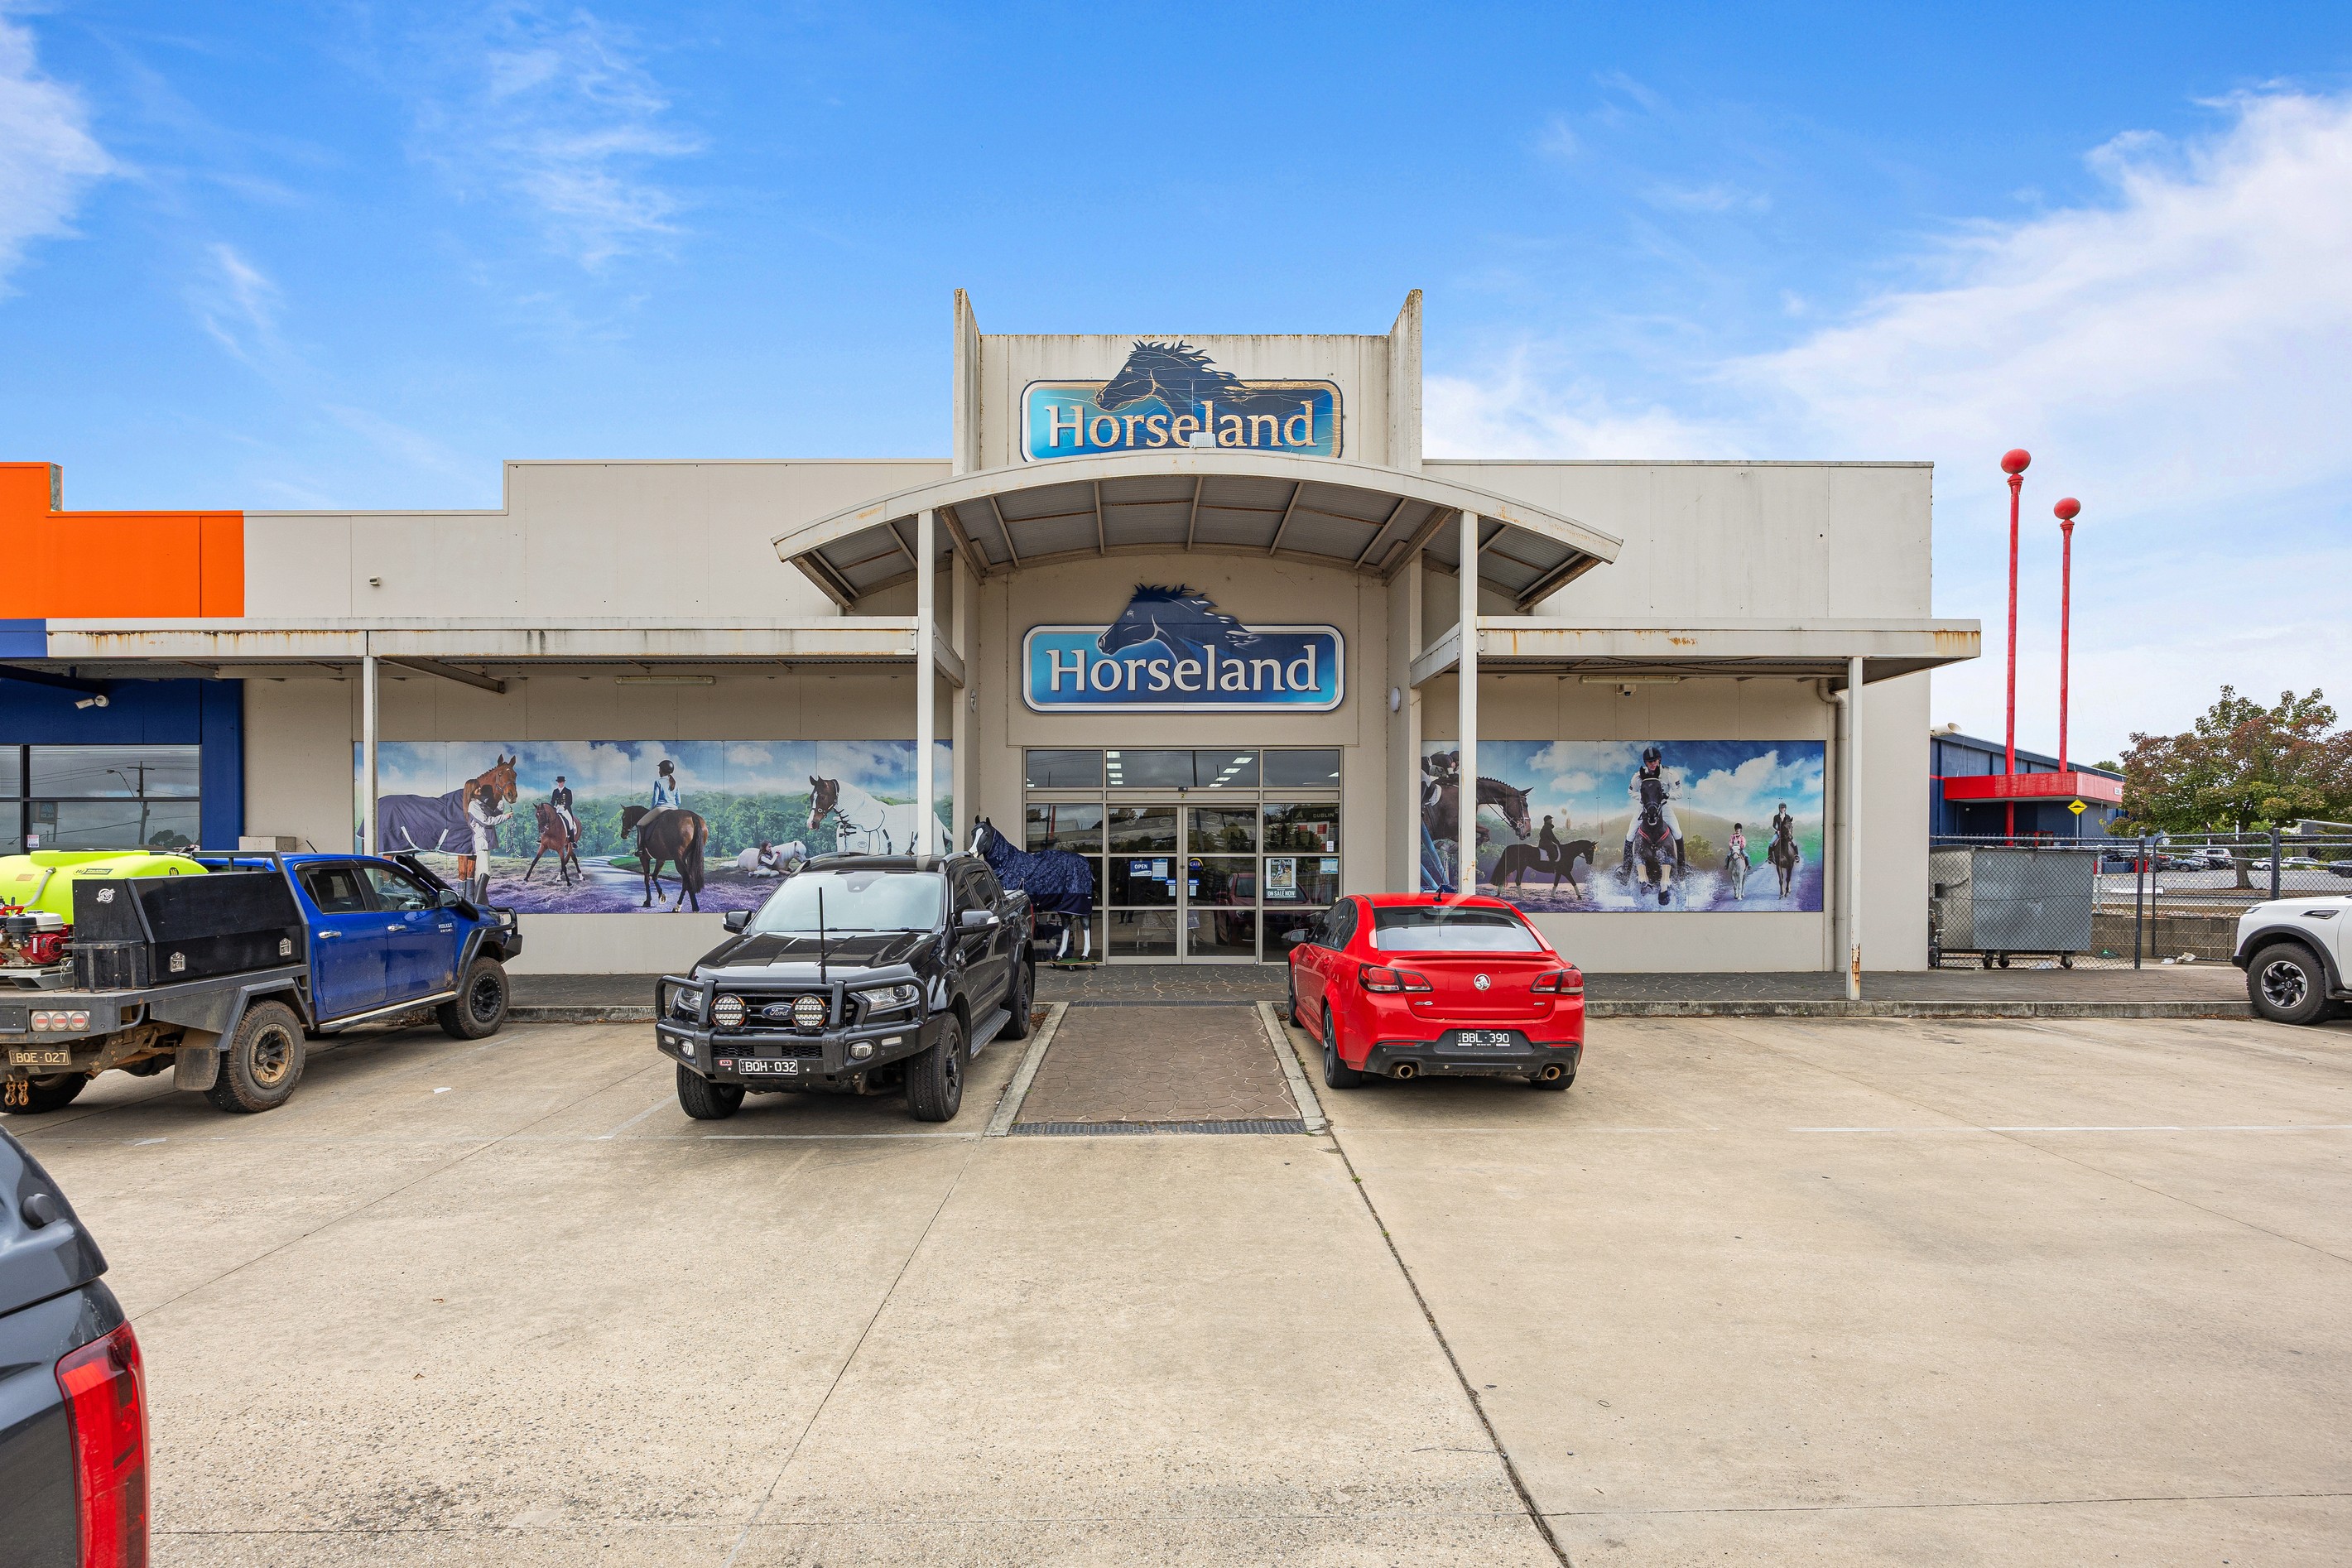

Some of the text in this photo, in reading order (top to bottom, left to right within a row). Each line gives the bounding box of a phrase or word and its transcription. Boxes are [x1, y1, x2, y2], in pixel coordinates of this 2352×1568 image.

[1044, 400, 1318, 448] Horseland
[1045, 644, 1321, 692] Horseland
[770, 1007, 789, 1016] Ford
